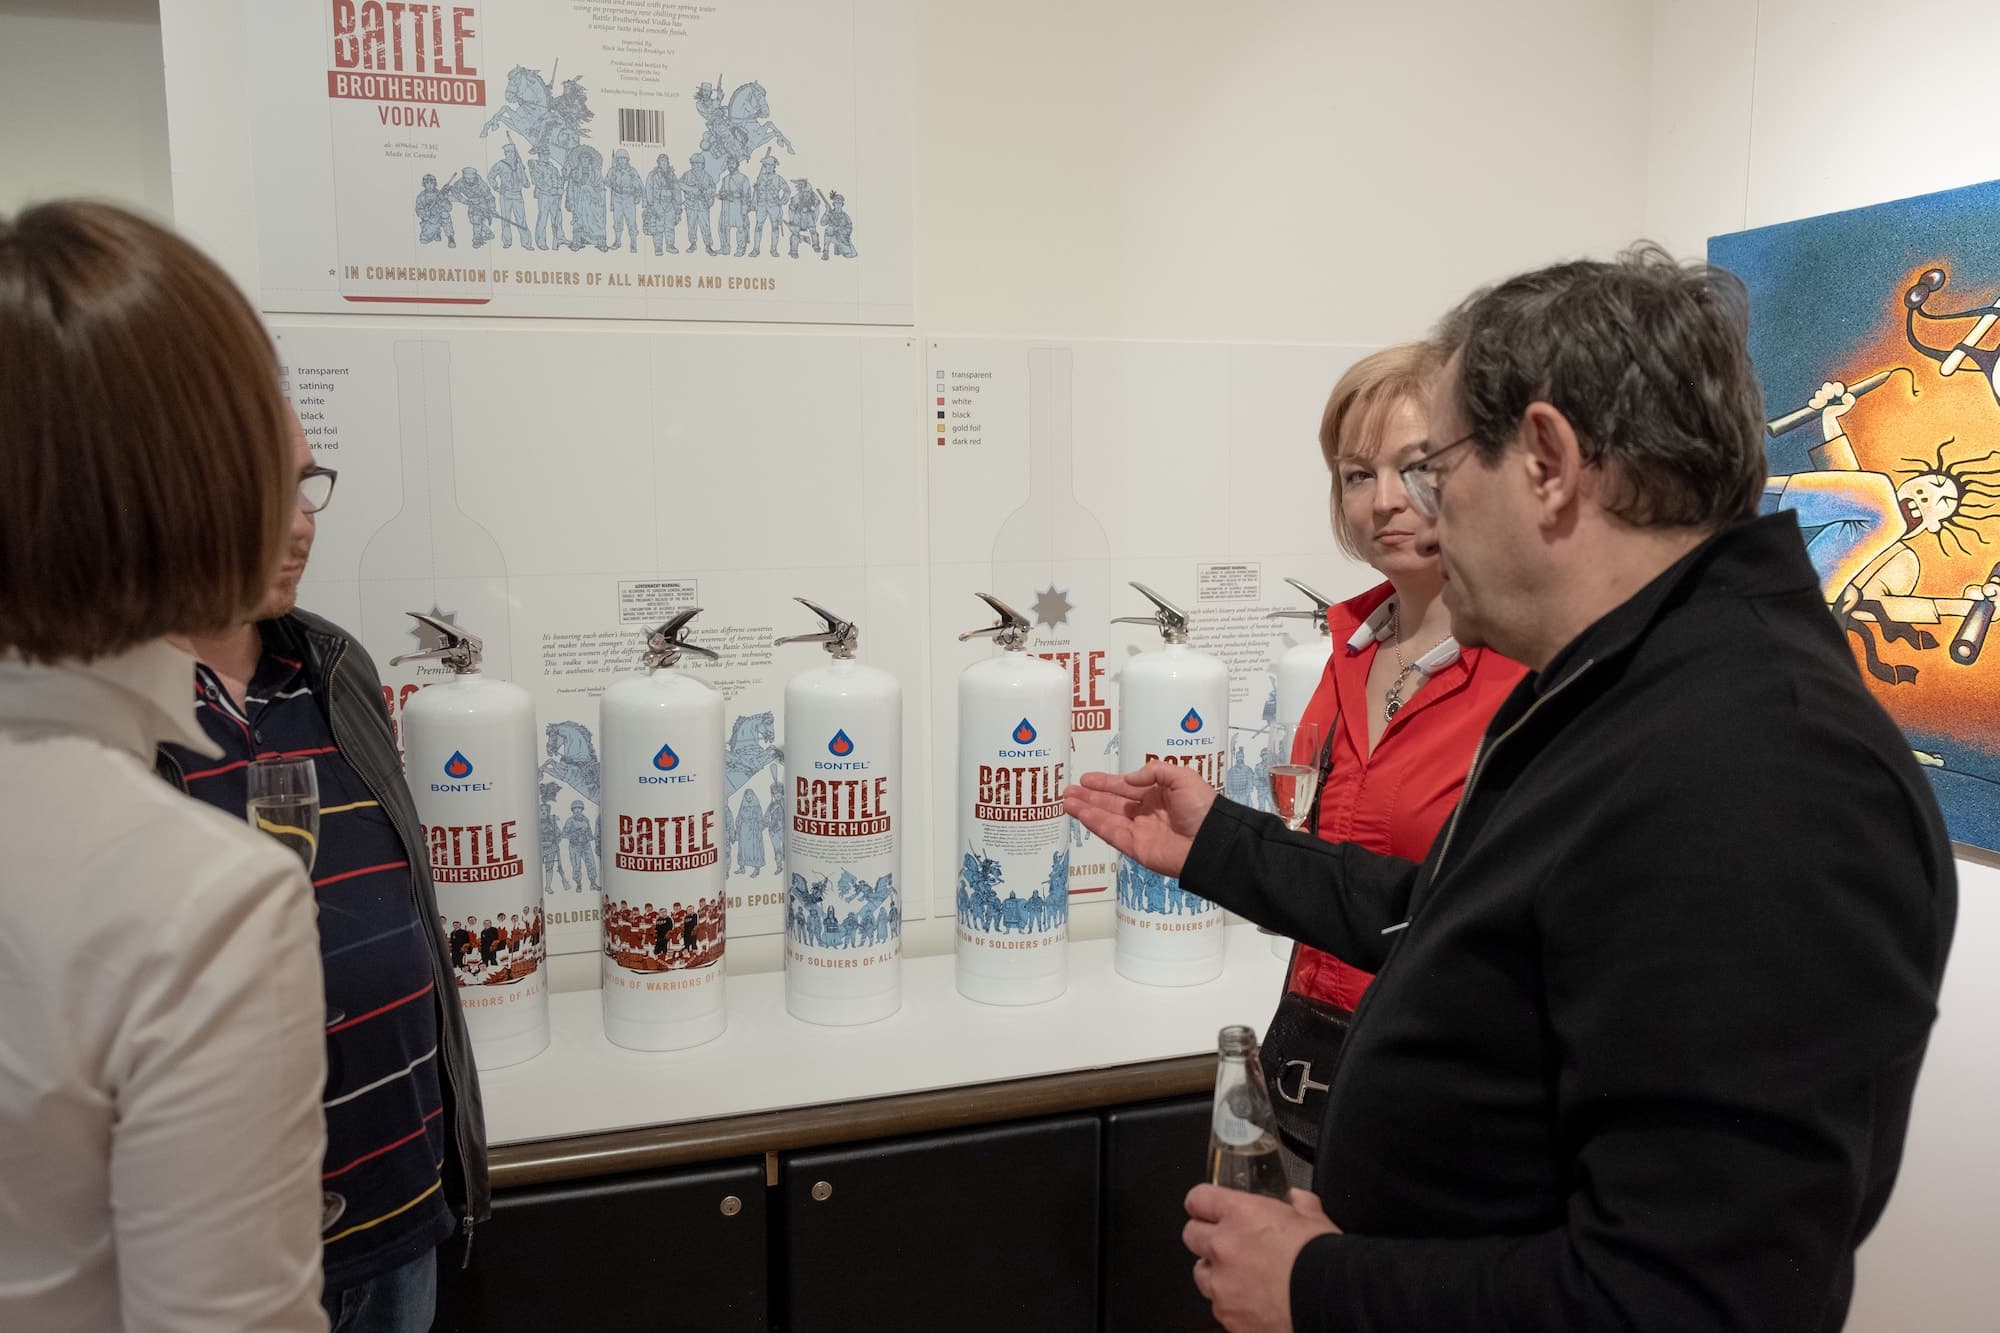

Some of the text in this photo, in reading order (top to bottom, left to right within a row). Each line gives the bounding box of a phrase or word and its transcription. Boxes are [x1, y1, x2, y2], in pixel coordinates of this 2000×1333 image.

[612, 15, 650, 24] Brotherhood
[652, 18, 671, 26] Vodka
[333, 0, 477, 76] BATTLE
[336, 74, 478, 103] BROTHERHOOD
[378, 105, 440, 128] VODKA
[344, 265, 776, 291] IN COMMEMORATION OF SOLDIERS OF ALL NATIONS AND EPOCHS
[298, 367, 349, 376] transparent
[951, 371, 992, 379] transparent
[299, 382, 335, 392] satining
[951, 385, 980, 393] satining
[300, 397, 325, 405] white
[301, 411, 325, 420] black
[324, 426, 338, 435] foil
[952, 424, 981, 433] gold foil
[308, 441, 339, 450] ark red
[952, 437, 982, 445] dark red
[553, 632, 582, 641] honoring
[583, 631, 597, 639] each
[559, 640, 578, 648] makes
[581, 640, 596, 648] them
[1033, 637, 1071, 647] Premium
[563, 658, 582, 666] vodka
[604, 656, 632, 666] produced
[416, 665, 451, 676] Premiu
[1167, 737, 1213, 746] BONTEL
[999, 749, 1048, 758] BONTEL
[815, 760, 868, 770] BONTEL
[638, 775, 694, 784] BONTEL
[979, 763, 1064, 805] BATTLE
[431, 783, 490, 792] BONTEL
[796, 776, 887, 819] BATTLE
[978, 804, 1064, 821] BROTHERHOOD
[797, 817, 887, 835] SISTERHOOD
[619, 810, 714, 855] BATTLE
[619, 852, 715, 871] BROTHERHOOD
[432, 863, 518, 881] OTHERHOOD
[546, 892, 785, 925] SOLDIER ND EPOCH
[1139, 920, 1151, 929] OF
[1155, 922, 1203, 932] SOLDIERS
[1206, 918, 1214, 927] OF
[976, 936, 985, 947] OF
[989, 940, 1039, 951] SOLDIERS
[1042, 936, 1053, 947] OF
[795, 951, 804, 963] OF
[808, 956, 859, 969] SOLDIERS
[863, 956, 875, 967] OF
[879, 951, 893, 963] ALL
[630, 979, 641, 989] OF
[646, 977, 701, 991] WARRIORS
[461, 996, 504, 1009] RRIORS
[510, 991, 522, 1003] OF
